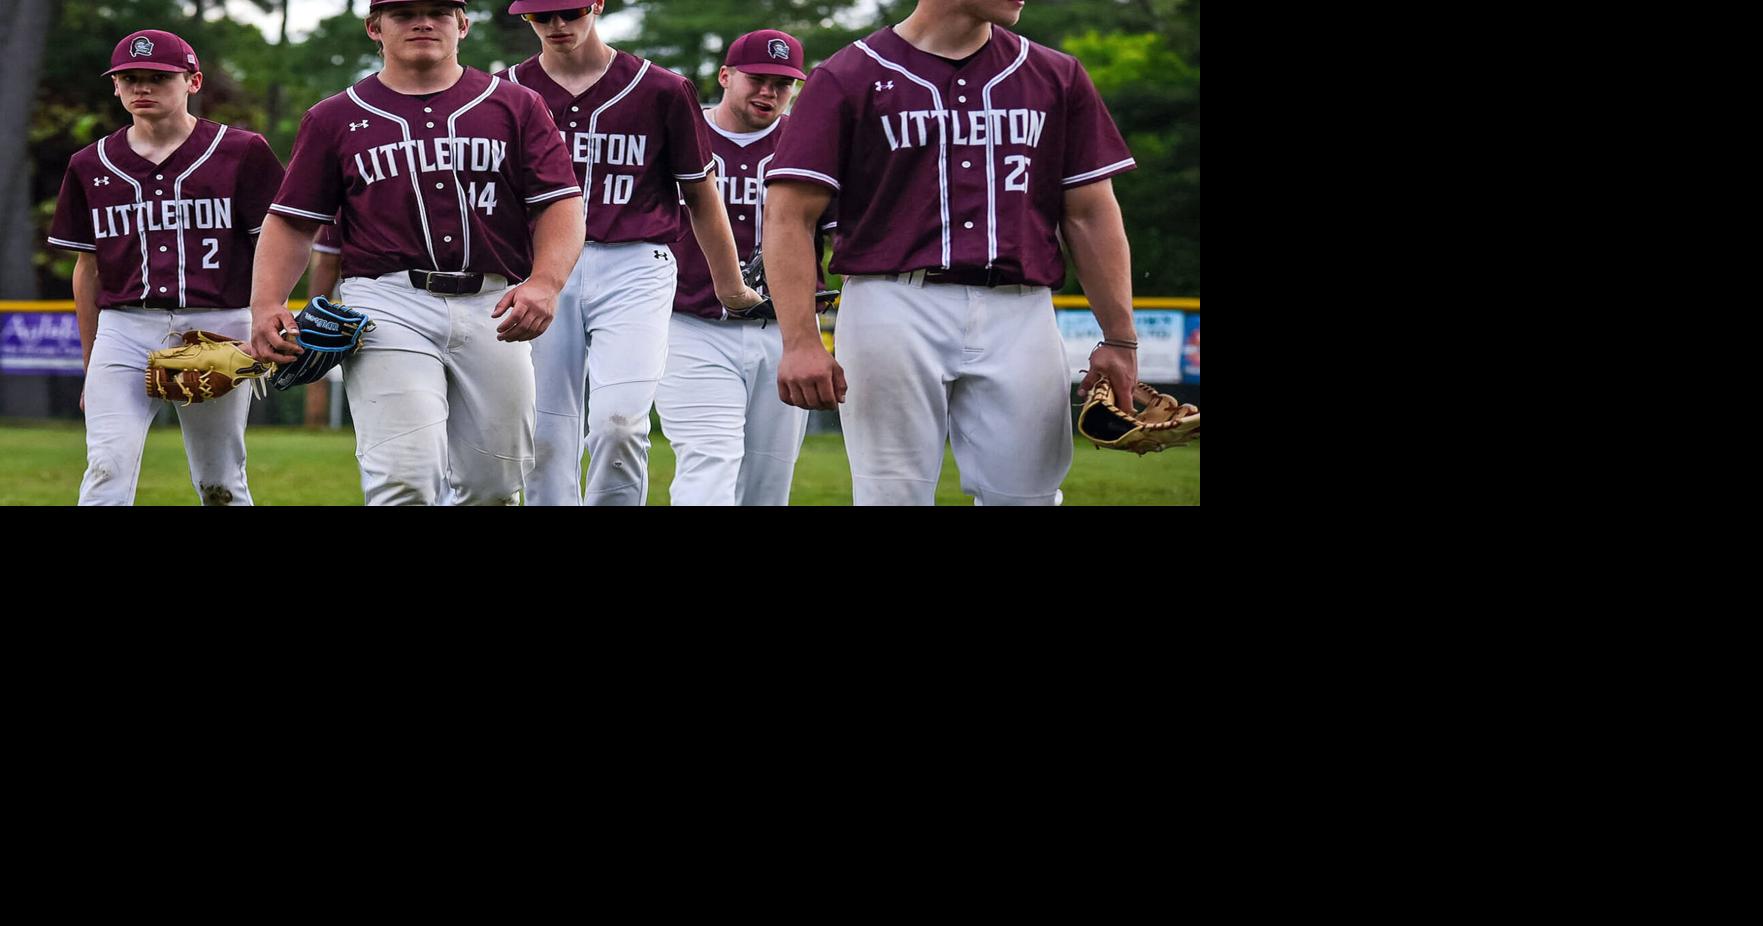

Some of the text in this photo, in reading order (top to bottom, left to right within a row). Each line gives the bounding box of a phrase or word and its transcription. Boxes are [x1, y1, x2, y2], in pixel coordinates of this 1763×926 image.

[880, 108, 1047, 152] LITTLETON
[354, 137, 507, 186] LITTLETON
[467, 181, 498, 216] 14
[602, 173, 634, 205] 10
[92, 198, 232, 239] LITTLETON
[202, 238, 220, 269] 2
